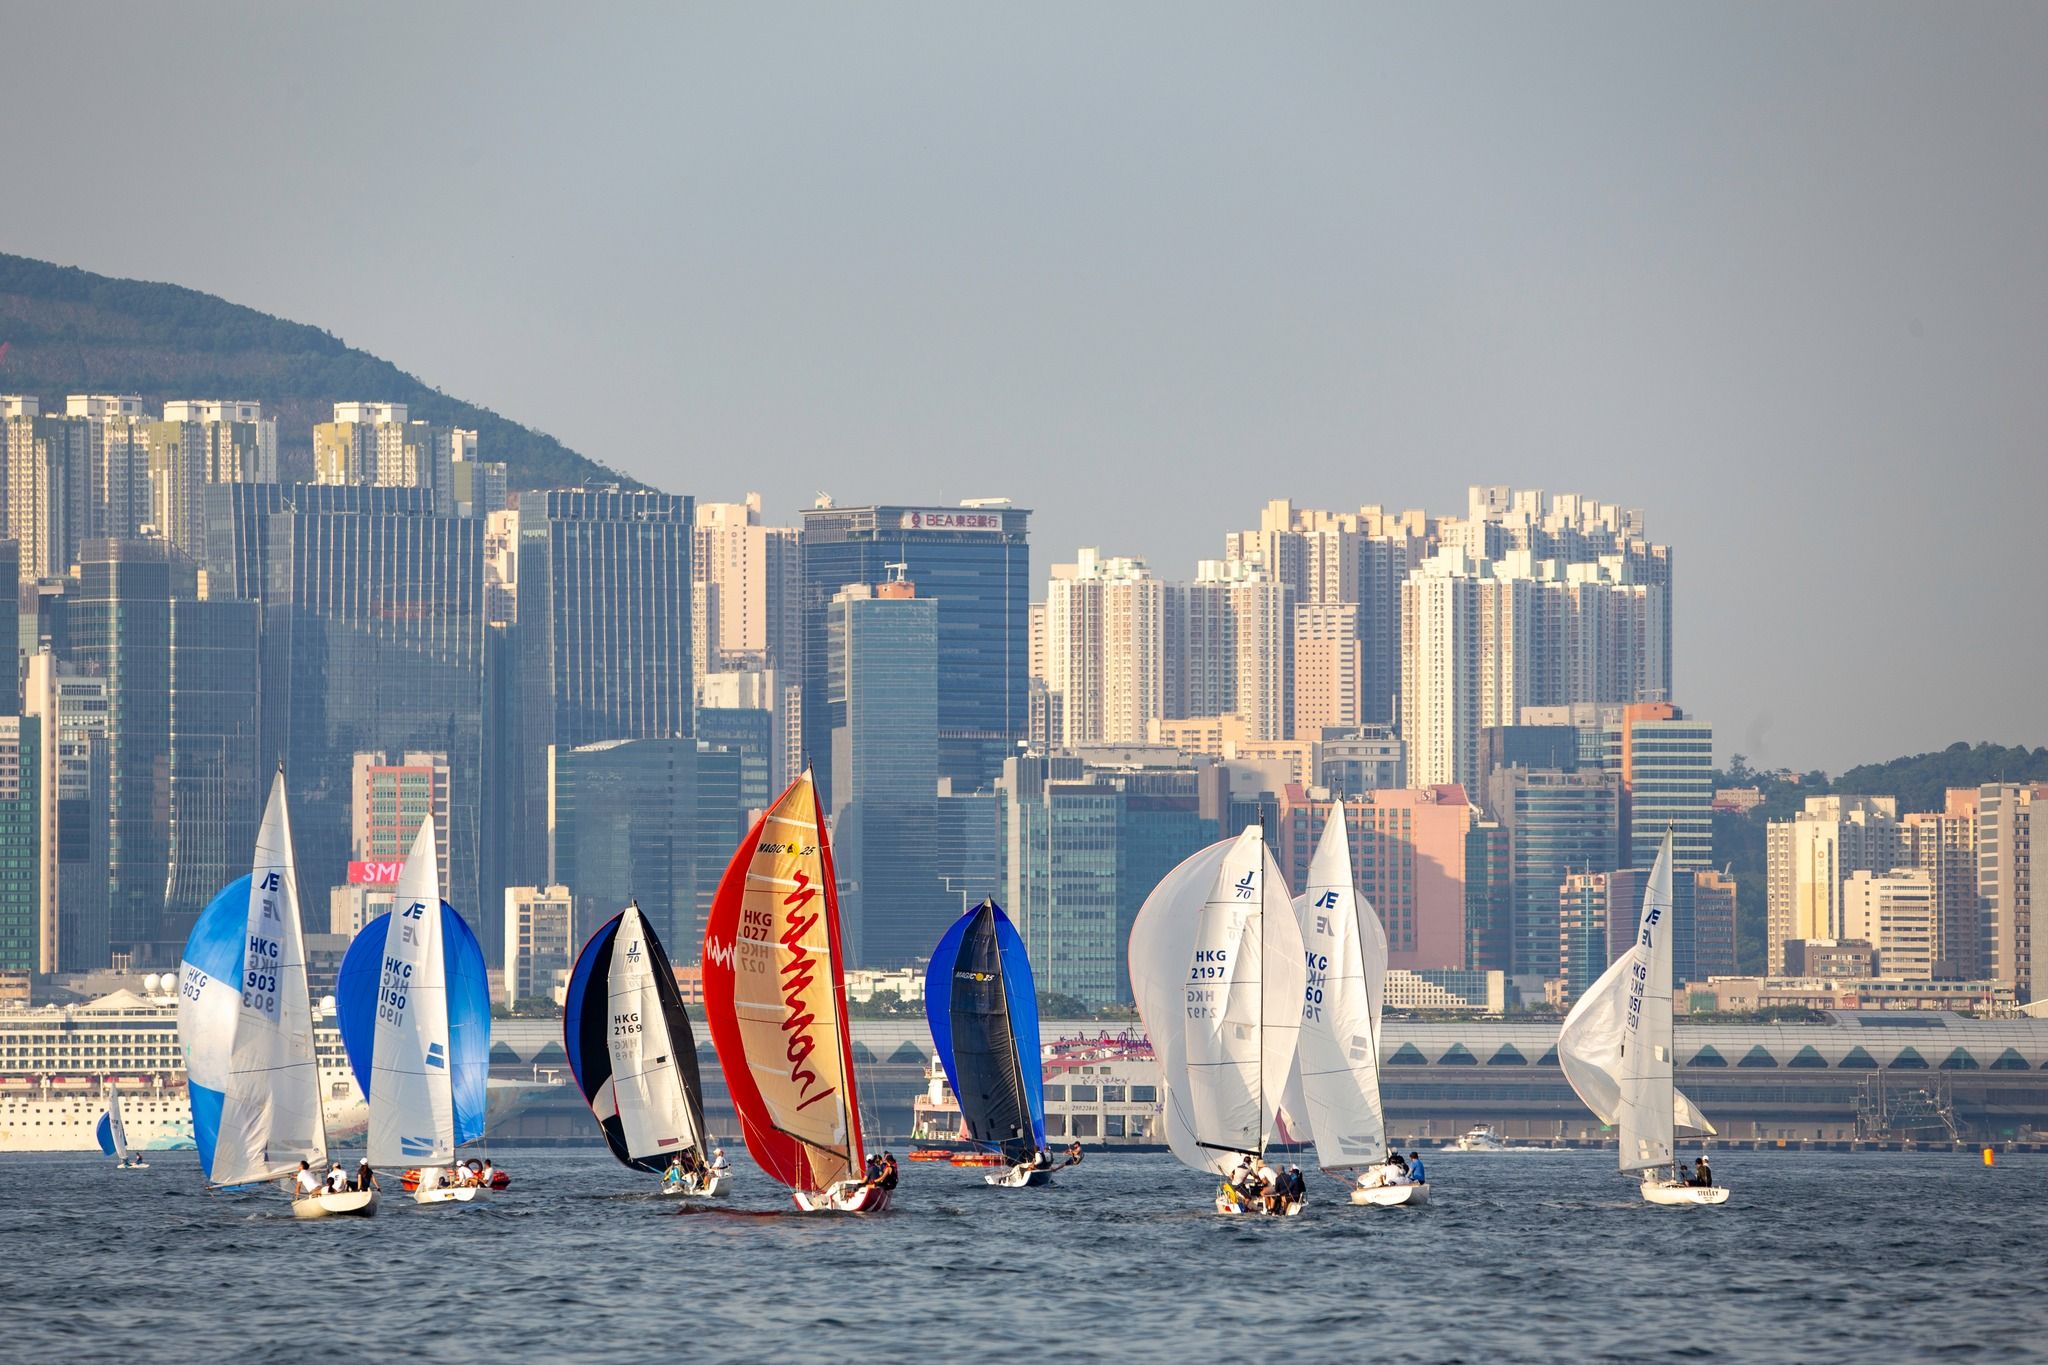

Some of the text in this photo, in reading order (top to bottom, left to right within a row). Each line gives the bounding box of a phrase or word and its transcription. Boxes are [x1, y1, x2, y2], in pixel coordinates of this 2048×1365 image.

[926, 514, 998, 528] BEA 東亞銀行
[757, 843, 816, 855] MAGIC 25
[1236, 888, 1252, 899] 70
[743, 909, 772, 927] HKG
[743, 926, 768, 941] 027
[250, 936, 278, 958] HKG
[1196, 950, 1226, 962] HKG
[385, 956, 413, 978] HKG
[1191, 966, 1225, 979] 2197
[186, 968, 208, 988] HKG
[247, 972, 276, 993] 903
[183, 982, 201, 1001] 903
[380, 987, 407, 1010] 1190
[614, 1013, 639, 1025] HKG
[614, 1024, 643, 1036] 2169
